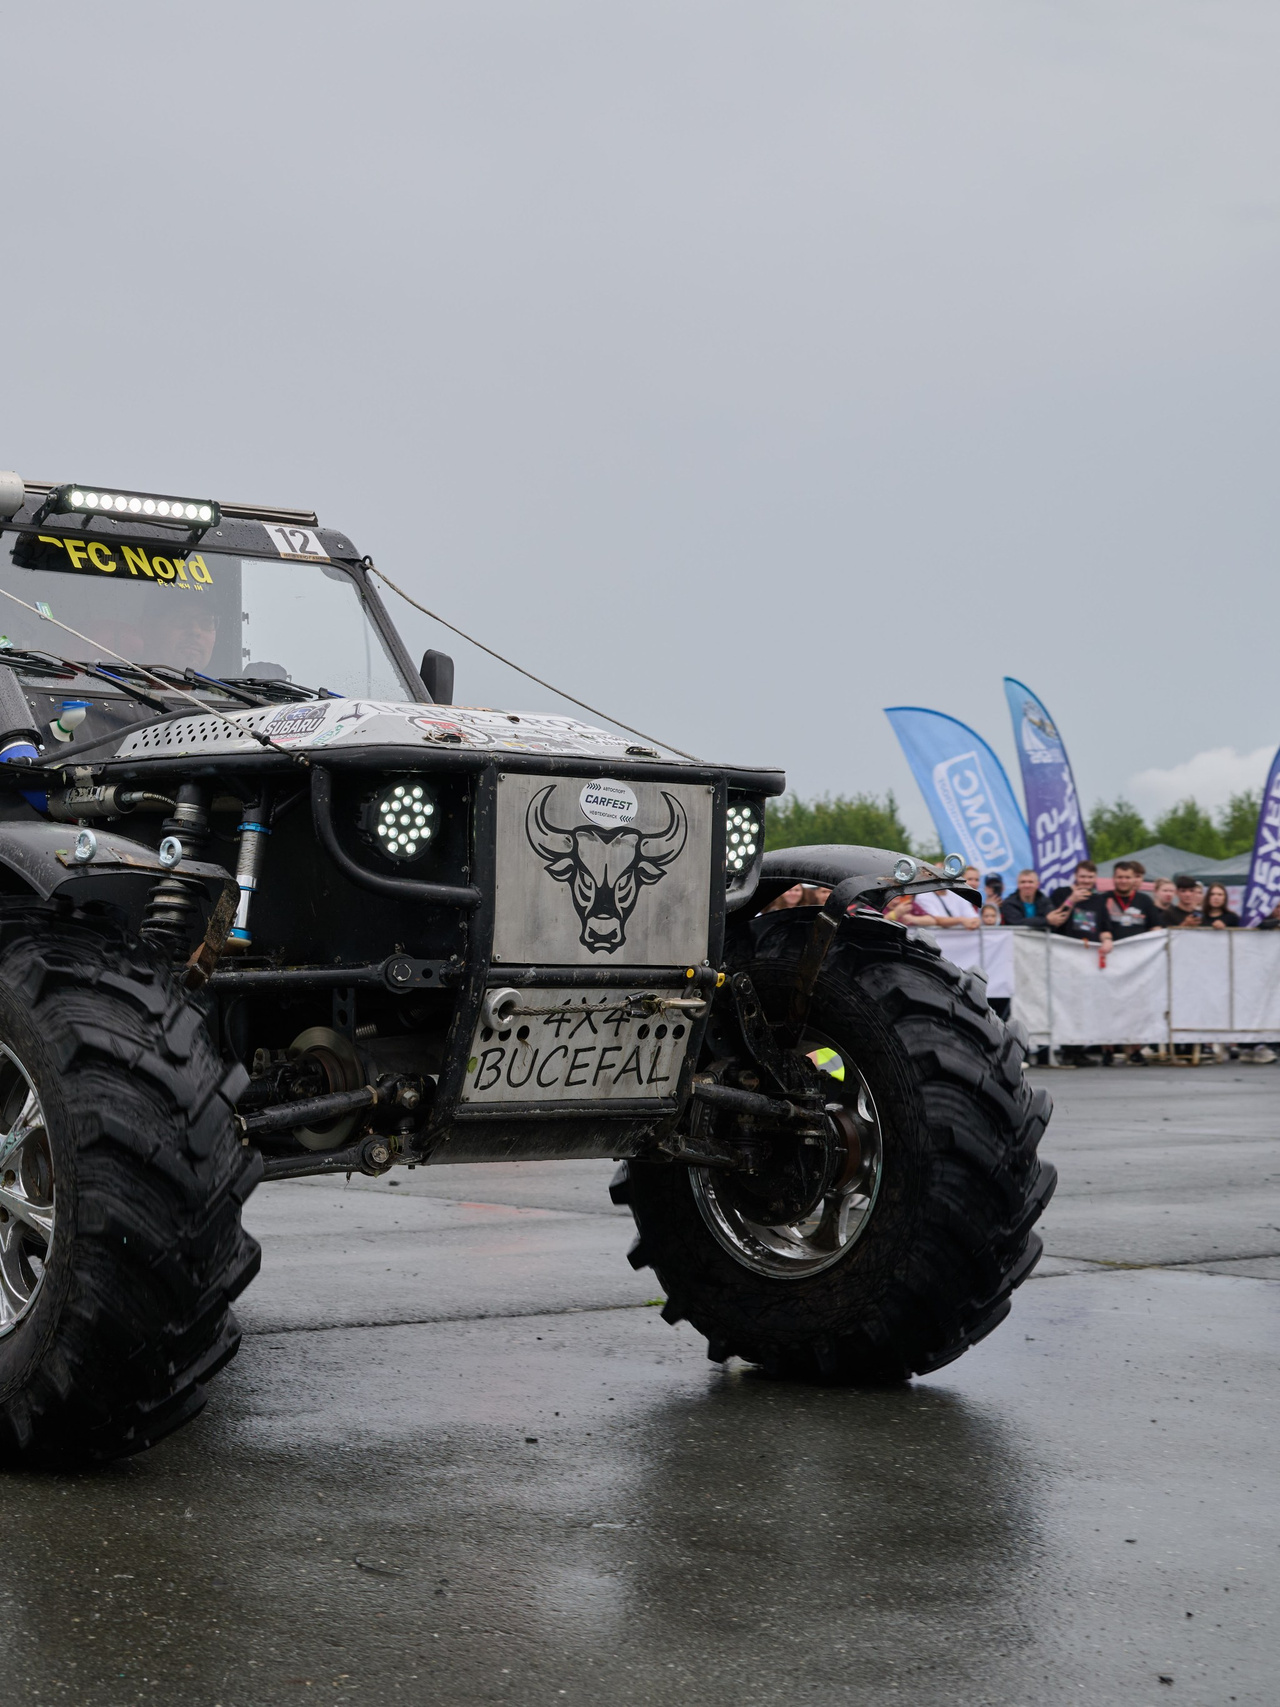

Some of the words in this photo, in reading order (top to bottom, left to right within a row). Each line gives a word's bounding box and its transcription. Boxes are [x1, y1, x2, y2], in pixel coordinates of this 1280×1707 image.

[275, 528, 319, 555] 12
[38, 535, 116, 572] FC
[121, 545, 213, 584] Nord
[263, 717, 325, 736] SUBARU
[585, 794, 633, 811] CARFEST
[473, 1044, 671, 1090] BUCEFAL
